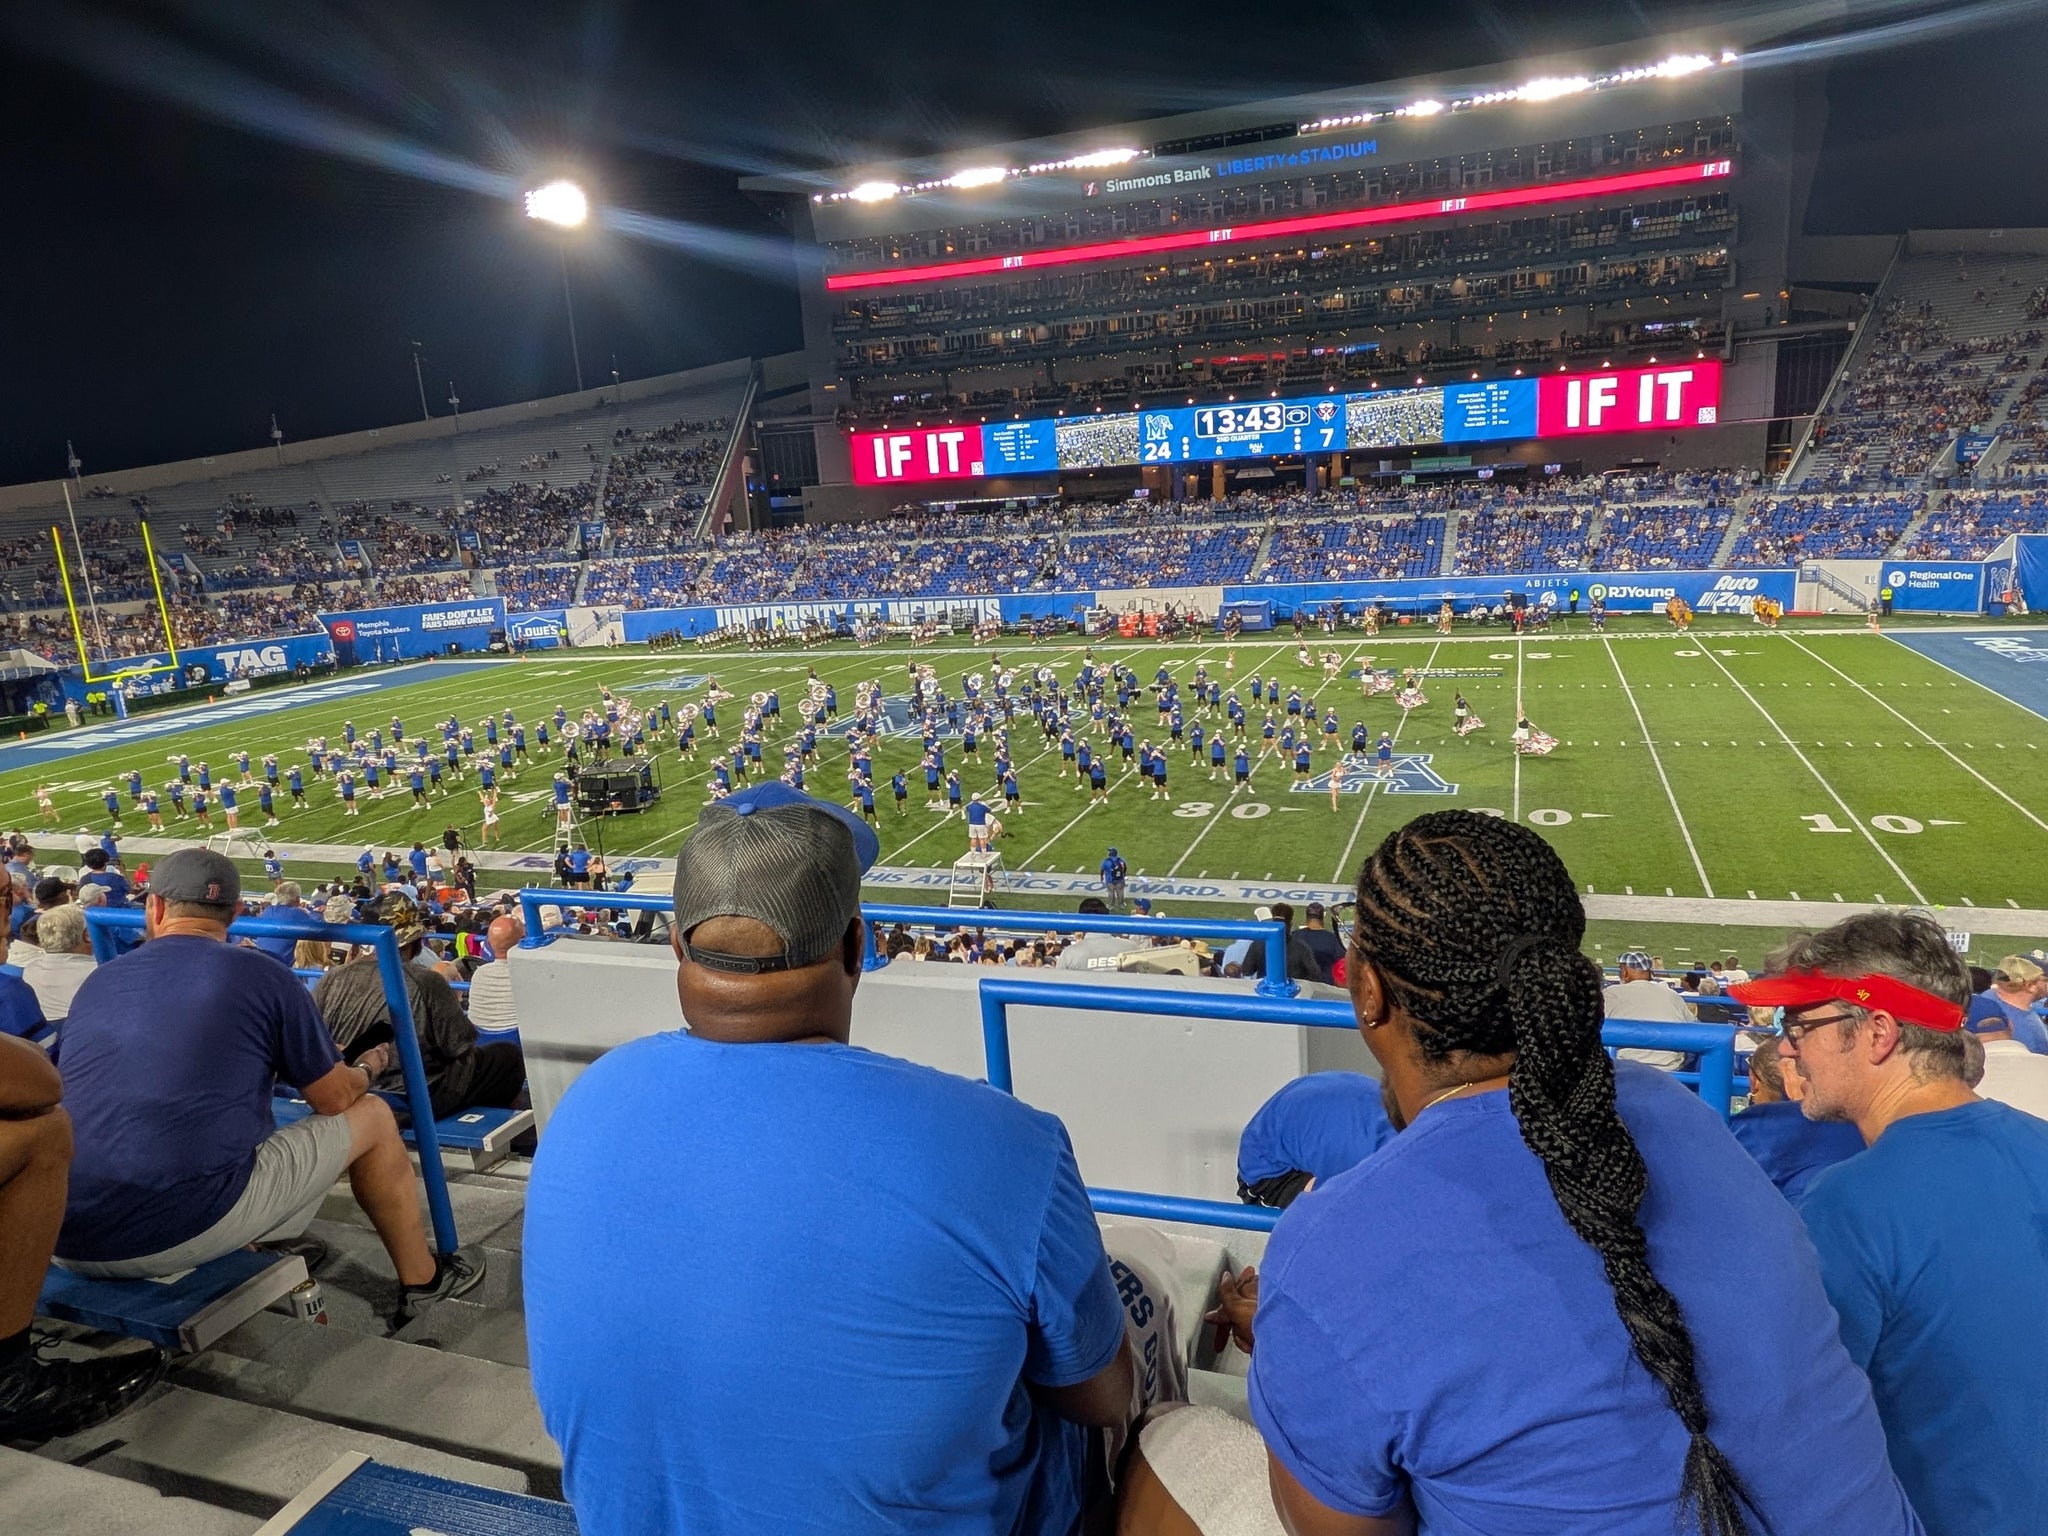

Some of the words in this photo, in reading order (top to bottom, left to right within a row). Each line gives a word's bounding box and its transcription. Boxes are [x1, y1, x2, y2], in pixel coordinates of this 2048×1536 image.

[1106, 173, 1171, 193] Simmons
[1174, 165, 1212, 183] Bank
[1217, 152, 1286, 177] LIBERTY
[1300, 139, 1377, 165] STADIUM
[1703, 163, 1715, 177] IF
[1718, 160, 1730, 174] IT
[1441, 200, 1452, 212] IF
[1456, 198, 1466, 210] IT
[1210, 230, 1220, 242] IF
[1222, 228, 1232, 240] IT
[1003, 258, 1012, 268] IF
[1013, 256, 1023, 266] IT
[1566, 377, 1618, 428] IF
[1638, 370, 1693, 423] IT
[1201, 406, 1281, 435] 13:43
[1216, 436, 1231, 444] 2ND
[1232, 434, 1260, 442] QUARTER
[1320, 428, 1334, 448] 7
[873, 436, 912, 478] IF
[926, 431, 964, 474] IT
[1144, 441, 1172, 461] 24
[1215, 446, 1223, 456] &
[1910, 570, 1952, 581] Regional
[1953, 572, 1974, 580] One
[1525, 578, 1569, 588] ABJETS
[1714, 575, 1759, 591] Auto
[1908, 580, 1940, 588] Health
[1608, 586, 1676, 599] RJYoung
[1716, 592, 1753, 607] Zon
[422, 612, 446, 622] FANS
[446, 609, 476, 619] DON'T
[476, 608, 494, 616] LET
[422, 620, 442, 629] FANS
[442, 618, 466, 627] DRIVE
[467, 615, 494, 624] DRUNK
[356, 620, 390, 630] Memphis
[383, 626, 411, 634] Dealers
[518, 624, 558, 638] LOWE'S
[216, 646, 286, 672] TAG
[1800, 814, 1924, 834] 10
[861, 872, 908, 883] HIS
[1066, 880, 1226, 898] FOWARD.
[1087, 956, 1118, 968] BES
[1107, 1254, 1154, 1328] ERS
